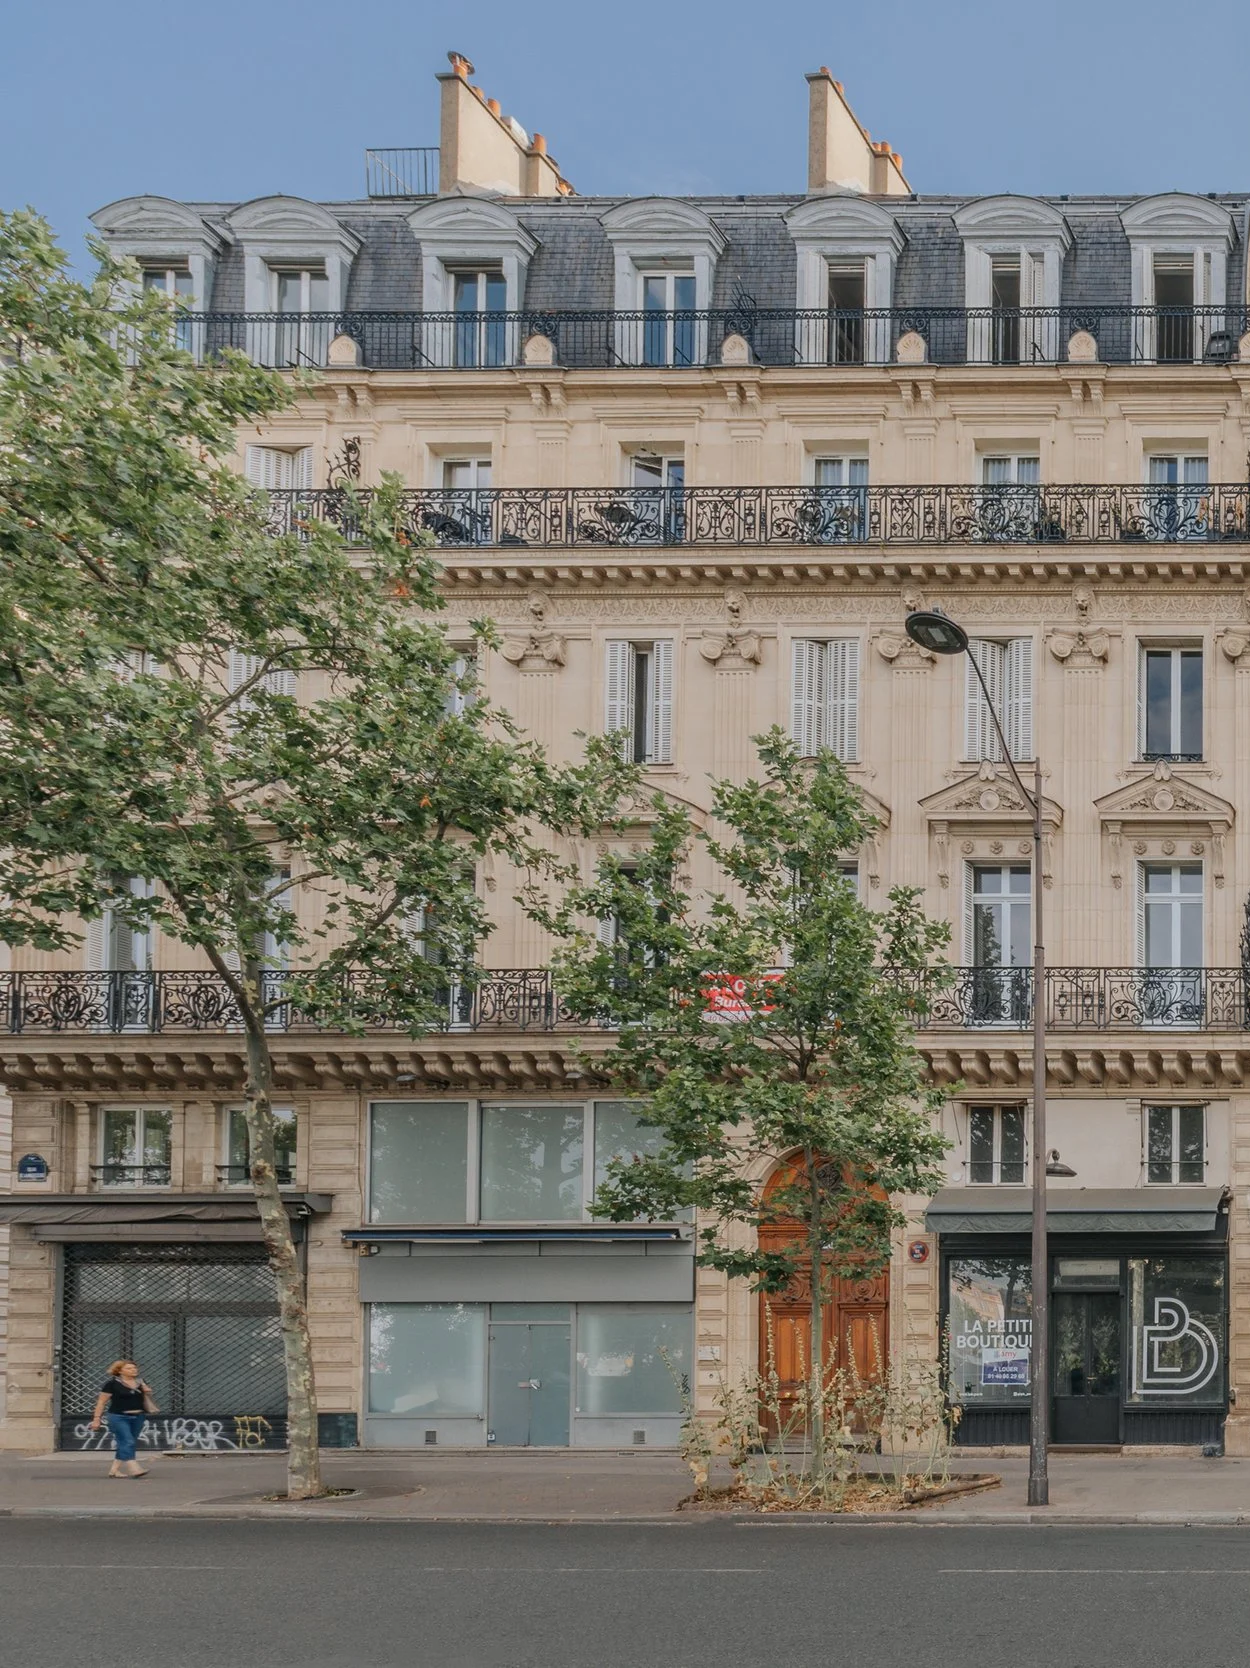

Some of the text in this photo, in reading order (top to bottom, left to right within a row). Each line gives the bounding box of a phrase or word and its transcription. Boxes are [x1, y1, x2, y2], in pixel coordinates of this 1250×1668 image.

[964, 1319, 1032, 1333] LA PETIT
[956, 1334, 1032, 1349] BOUTIQU
